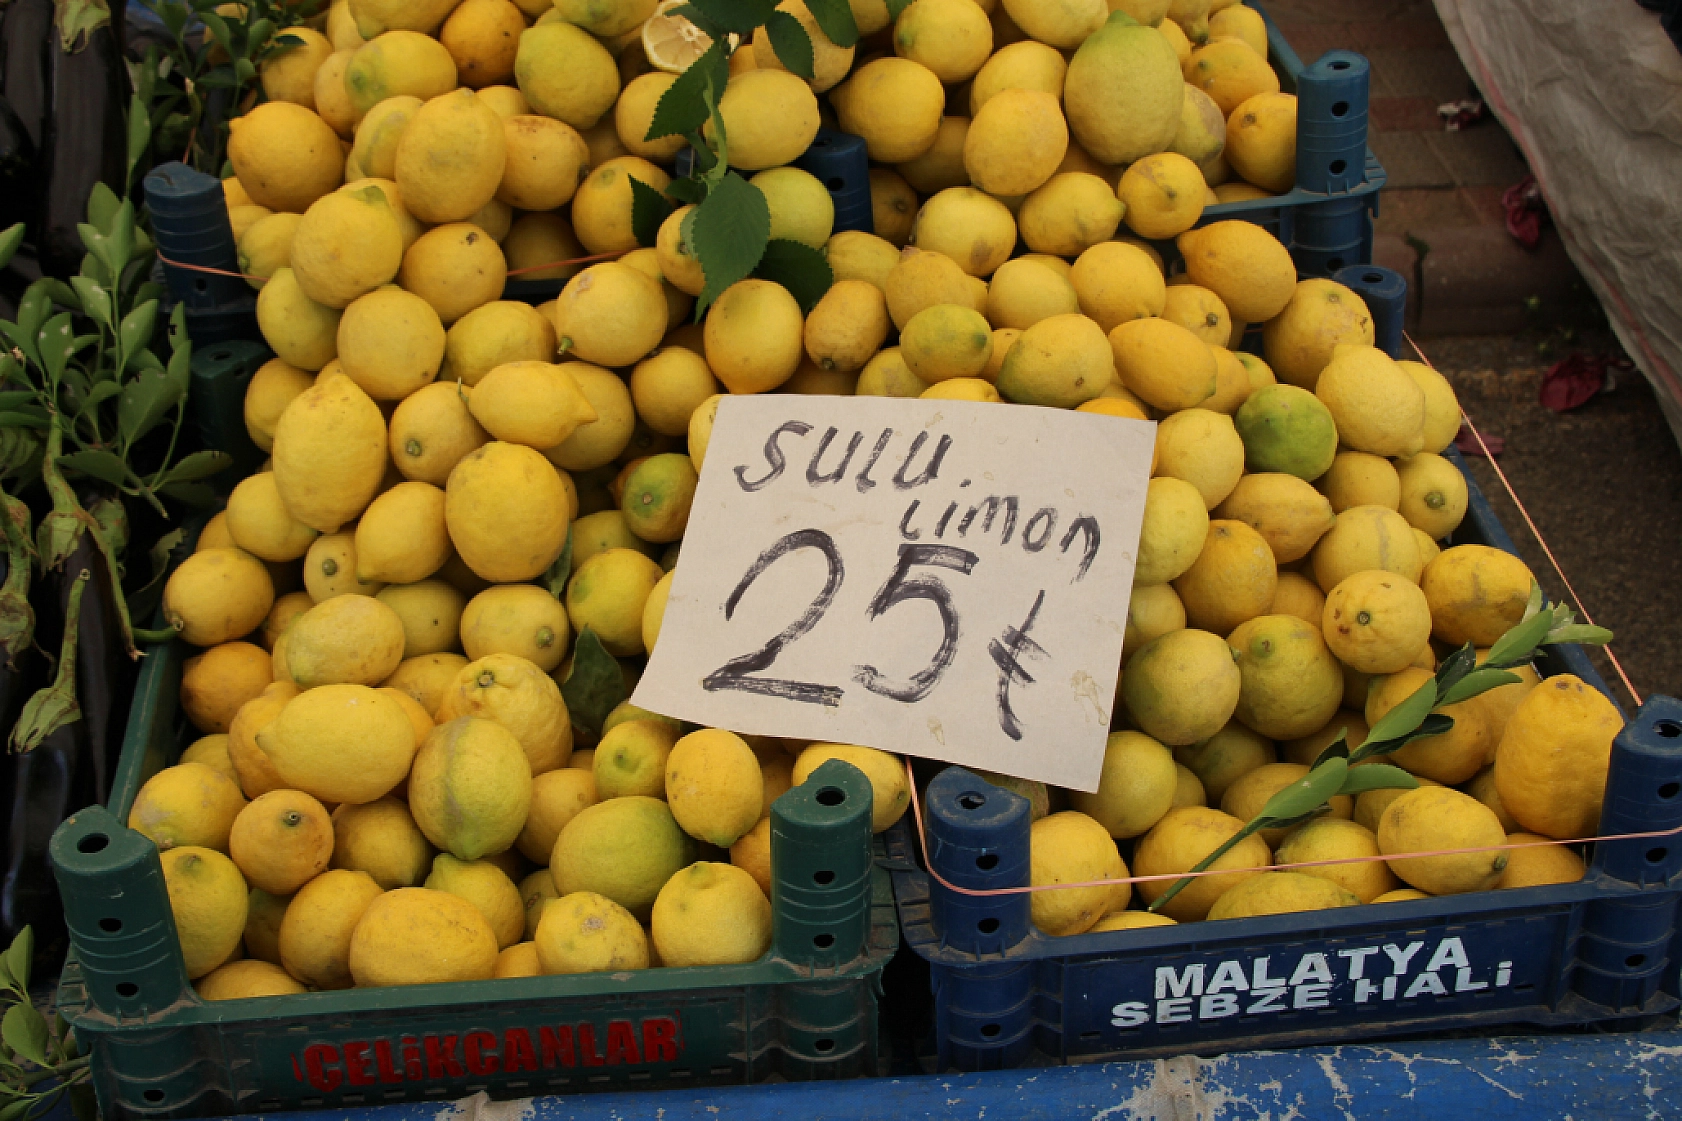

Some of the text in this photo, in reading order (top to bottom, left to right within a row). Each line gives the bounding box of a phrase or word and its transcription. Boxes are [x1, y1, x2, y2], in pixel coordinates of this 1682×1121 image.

[734, 420, 953, 493] SULU
[1154, 936, 1470, 999] MALATYA
[1111, 982, 1333, 1027] SEBZE
